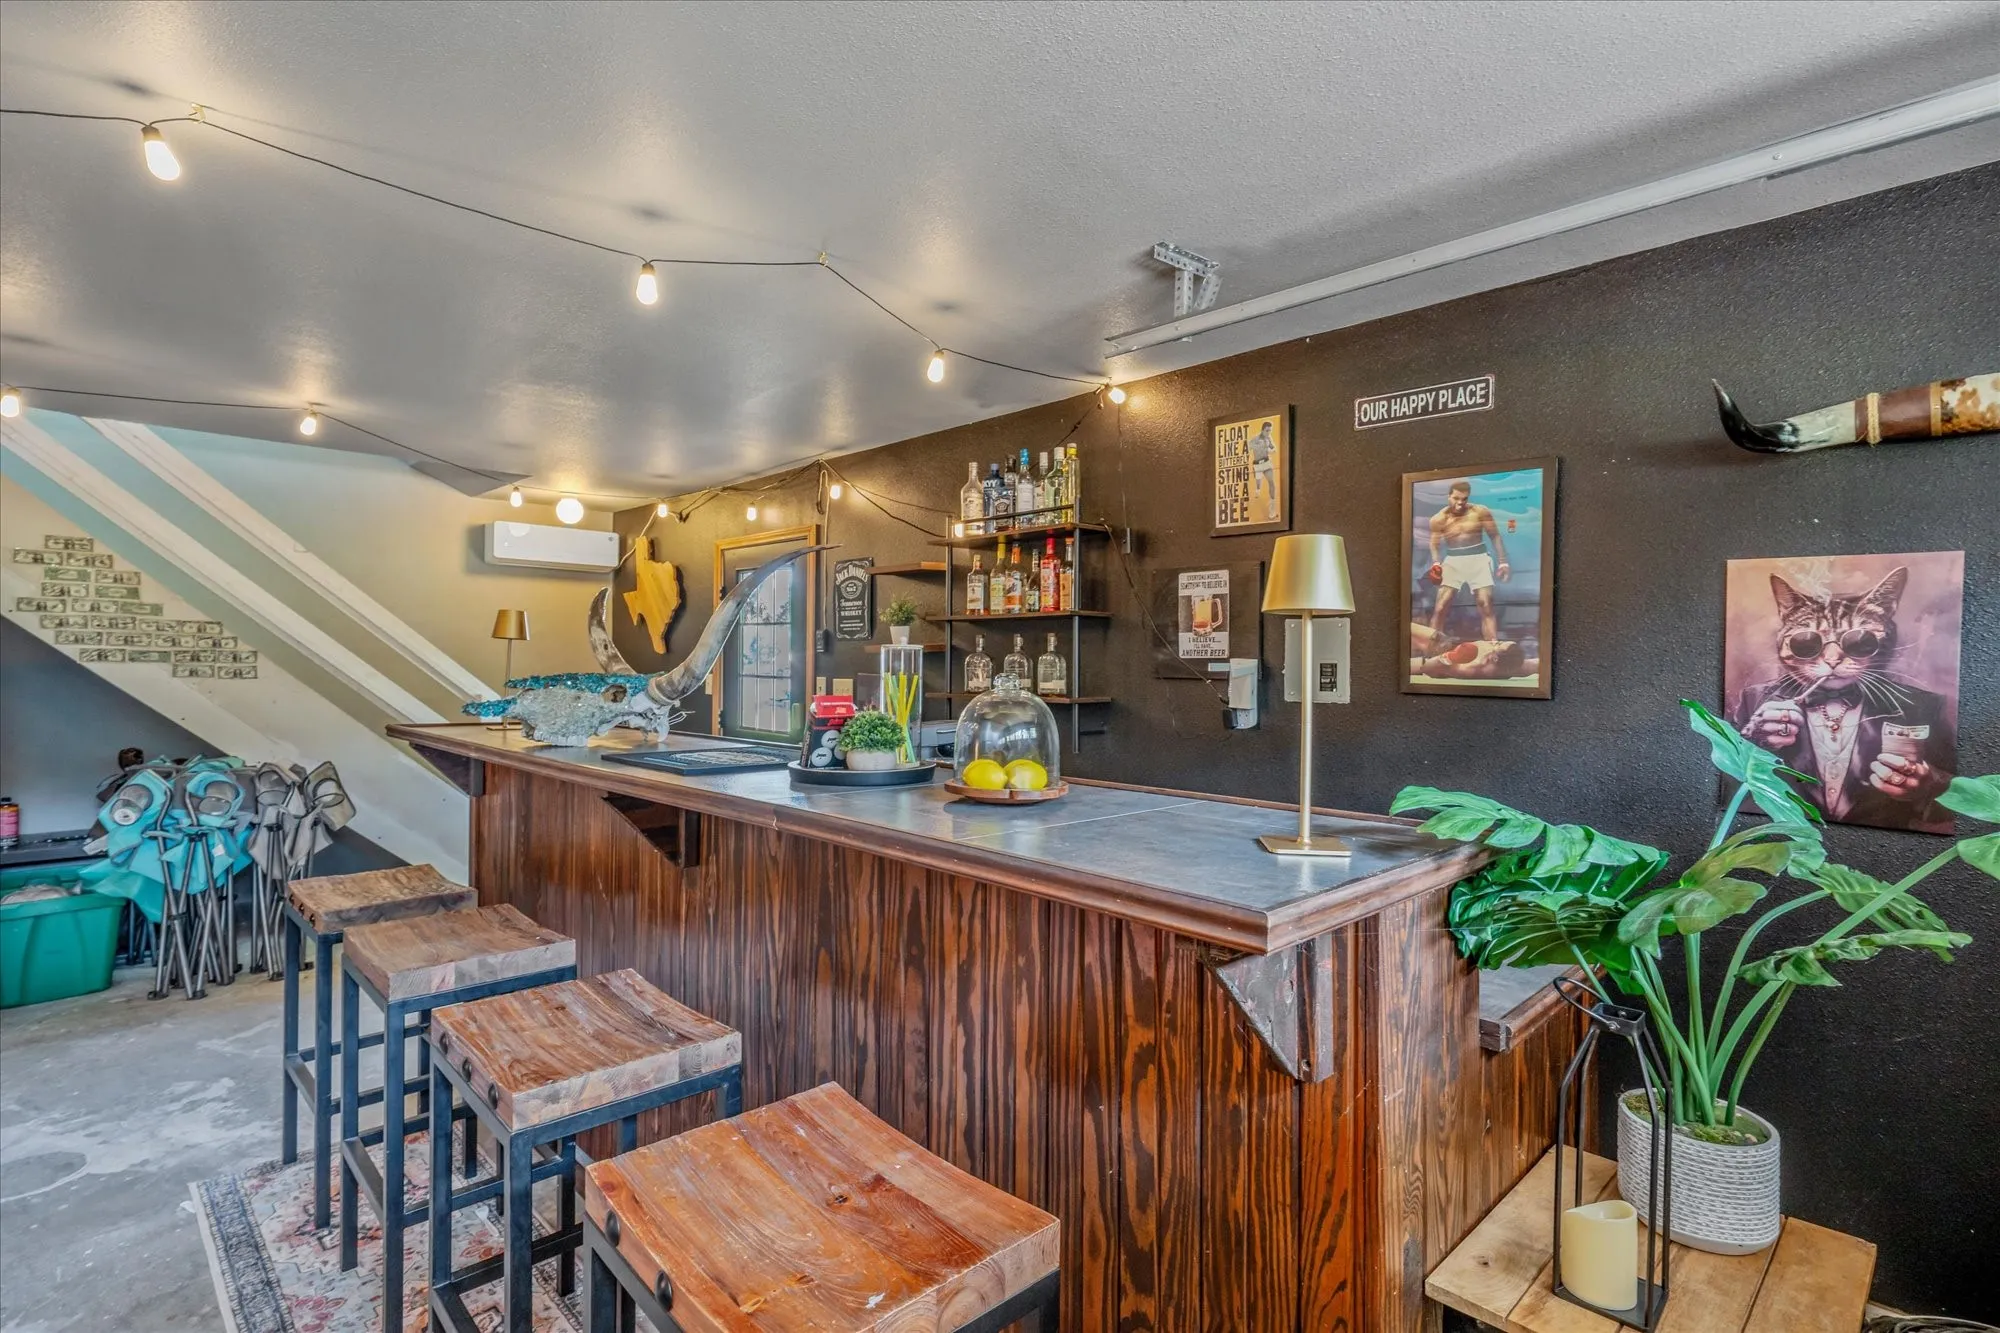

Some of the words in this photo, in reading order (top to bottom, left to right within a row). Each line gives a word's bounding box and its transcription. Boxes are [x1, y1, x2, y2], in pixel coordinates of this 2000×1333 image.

[1361, 400, 1388, 422] OUR
[1391, 391, 1437, 418] HAPPY
[1439, 382, 1487, 410] PLACE
[1218, 425, 1249, 443] FLOAT
[1218, 443, 1239, 458] LIKE
[1242, 441, 1249, 457] A
[1218, 456, 1249, 467] BUTTERFLY
[1218, 467, 1249, 485] STING
[1218, 484, 1239, 499] LIKE
[1242, 482, 1249, 498] A
[1218, 498, 1249, 525] BEE
[835, 570, 848, 584] JACK
[848, 565, 868, 582] DANIELS
